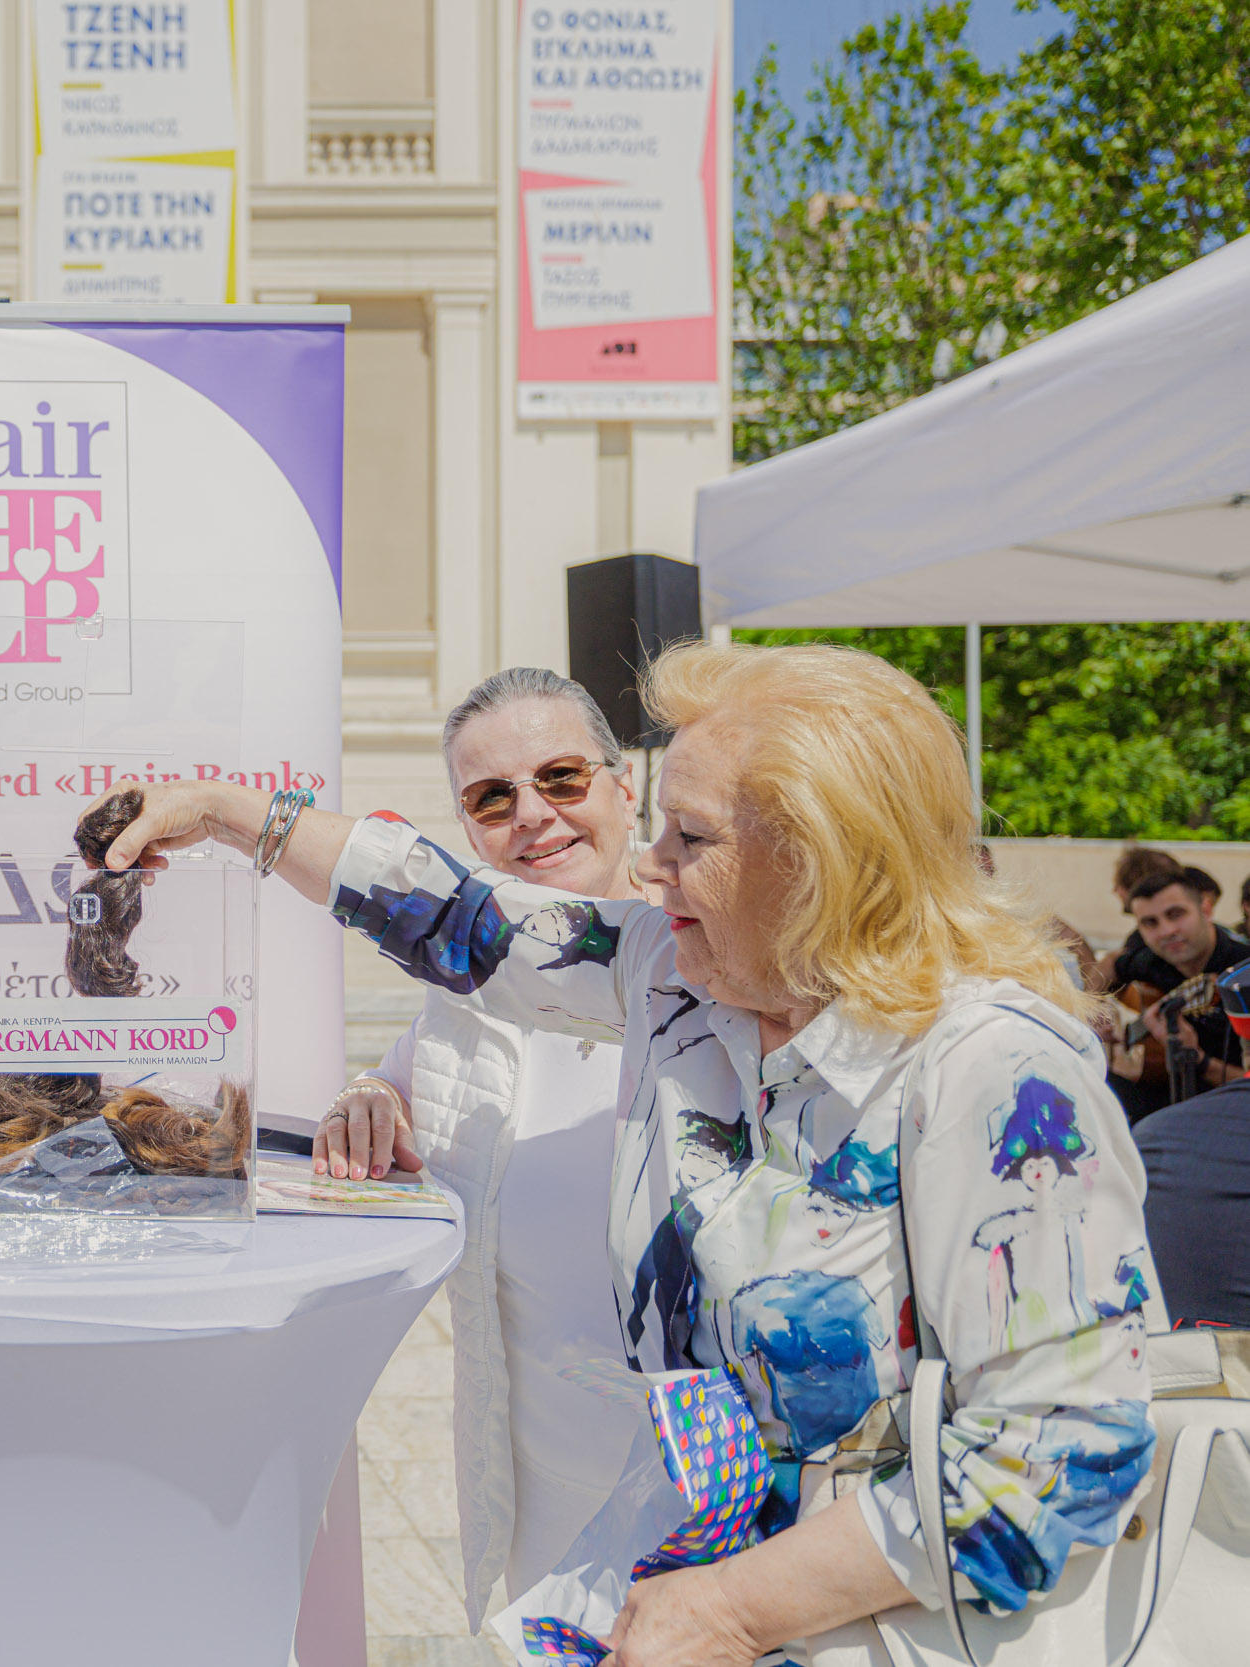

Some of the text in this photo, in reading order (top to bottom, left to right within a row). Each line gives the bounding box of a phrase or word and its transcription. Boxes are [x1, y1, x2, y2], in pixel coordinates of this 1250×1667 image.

[65, 4, 186, 33] ΤΖΕΝΗ
[532, 9, 552, 31] Ο
[65, 41, 186, 70] ΤΖΕΝΗ
[533, 39, 655, 59] ΕΓΚΛΗΜΑ
[533, 68, 702, 90] ΚΑΙ ΑΘΩΩΣΗ
[64, 192, 214, 217] ΠΟΤΕ ΤΗΝ
[64, 226, 203, 252] ΚΥΡΙΑΚΗ
[544, 223, 652, 245] ΜΕΡΙΛΙΝ
[14, 682, 84, 705] Group
[23, 1017, 62, 1026] ΚΕΝΤΡΑ
[128, 1028, 209, 1051] KORD
[128, 1056, 208, 1065] ΚΛΙΝΙΚΗ ΜΑΛΛΙΩΝ
